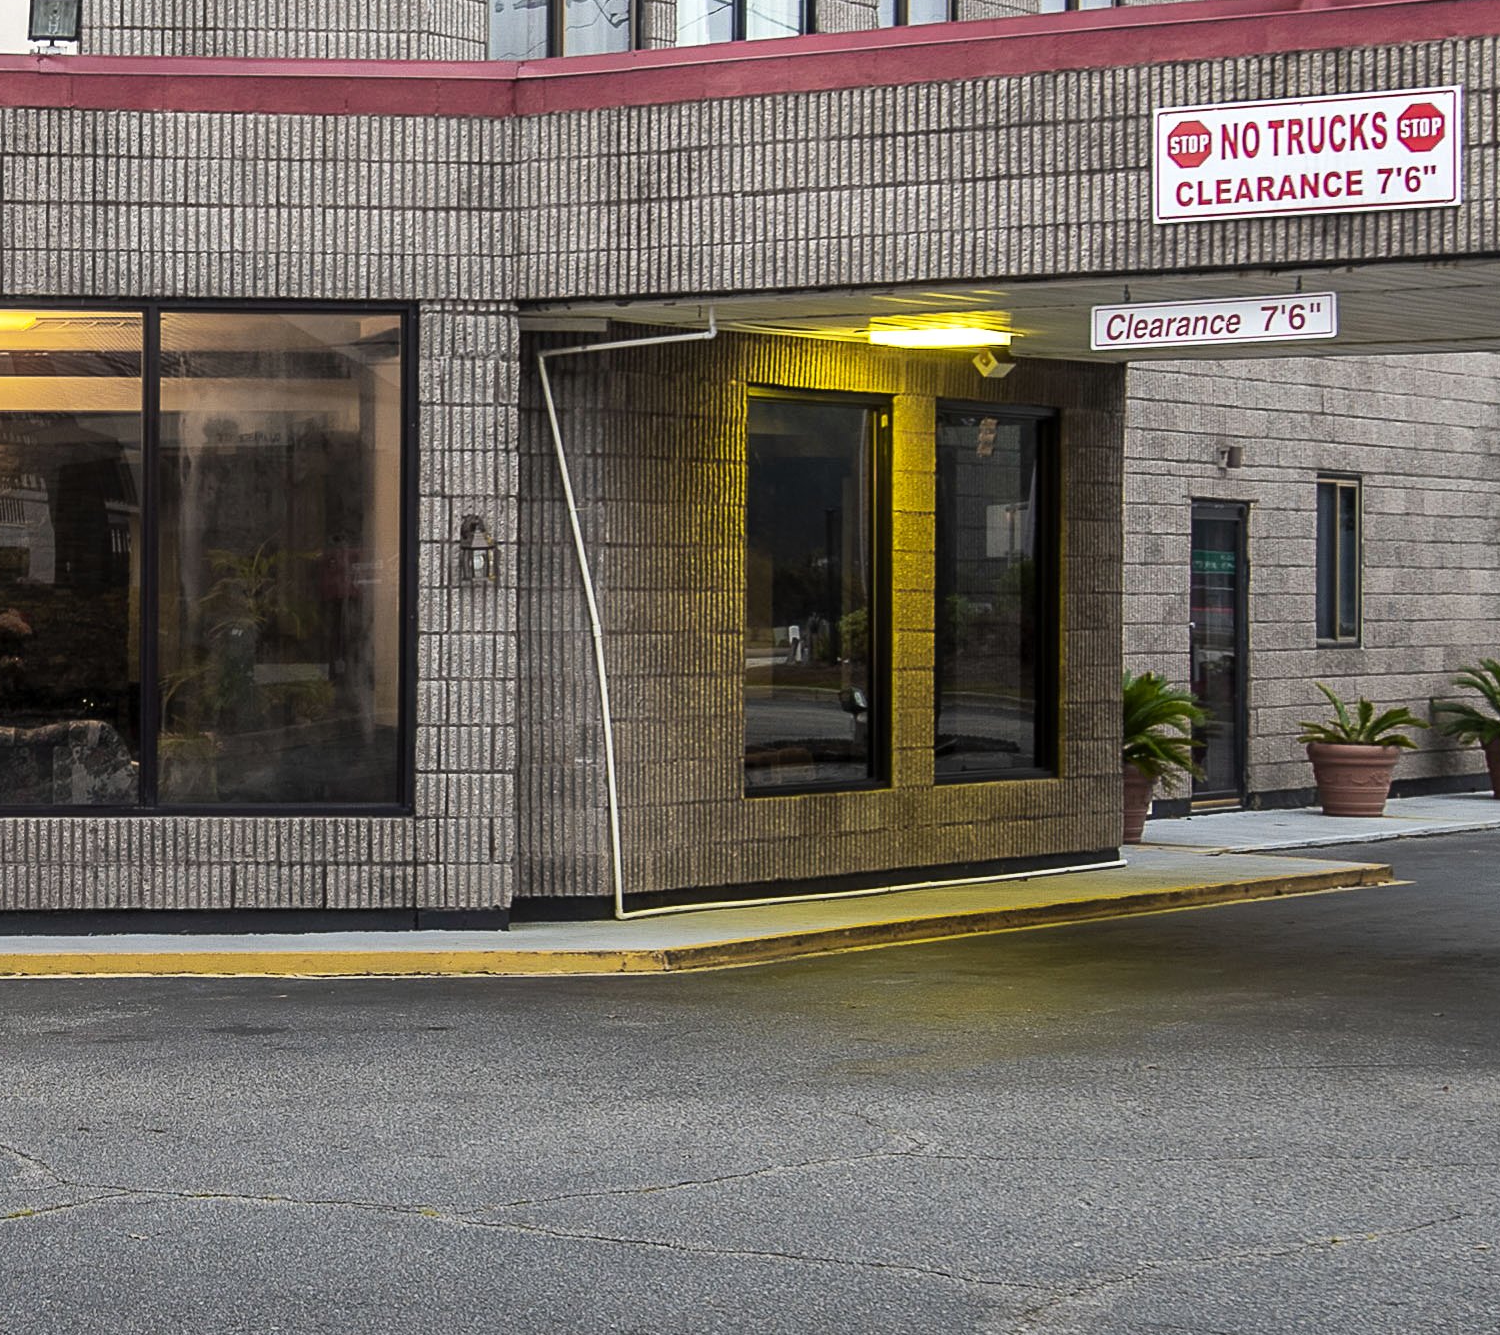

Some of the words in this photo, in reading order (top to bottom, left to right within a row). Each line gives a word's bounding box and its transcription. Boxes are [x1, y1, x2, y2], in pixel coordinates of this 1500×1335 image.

[1169, 132, 1209, 155] STOP
[1221, 121, 1260, 160] NO
[1268, 111, 1388, 156] TRUCKS
[1400, 117, 1441, 139] STOP
[1175, 169, 1363, 207] CLEARANCE
[1106, 313, 1241, 341] Clearance
